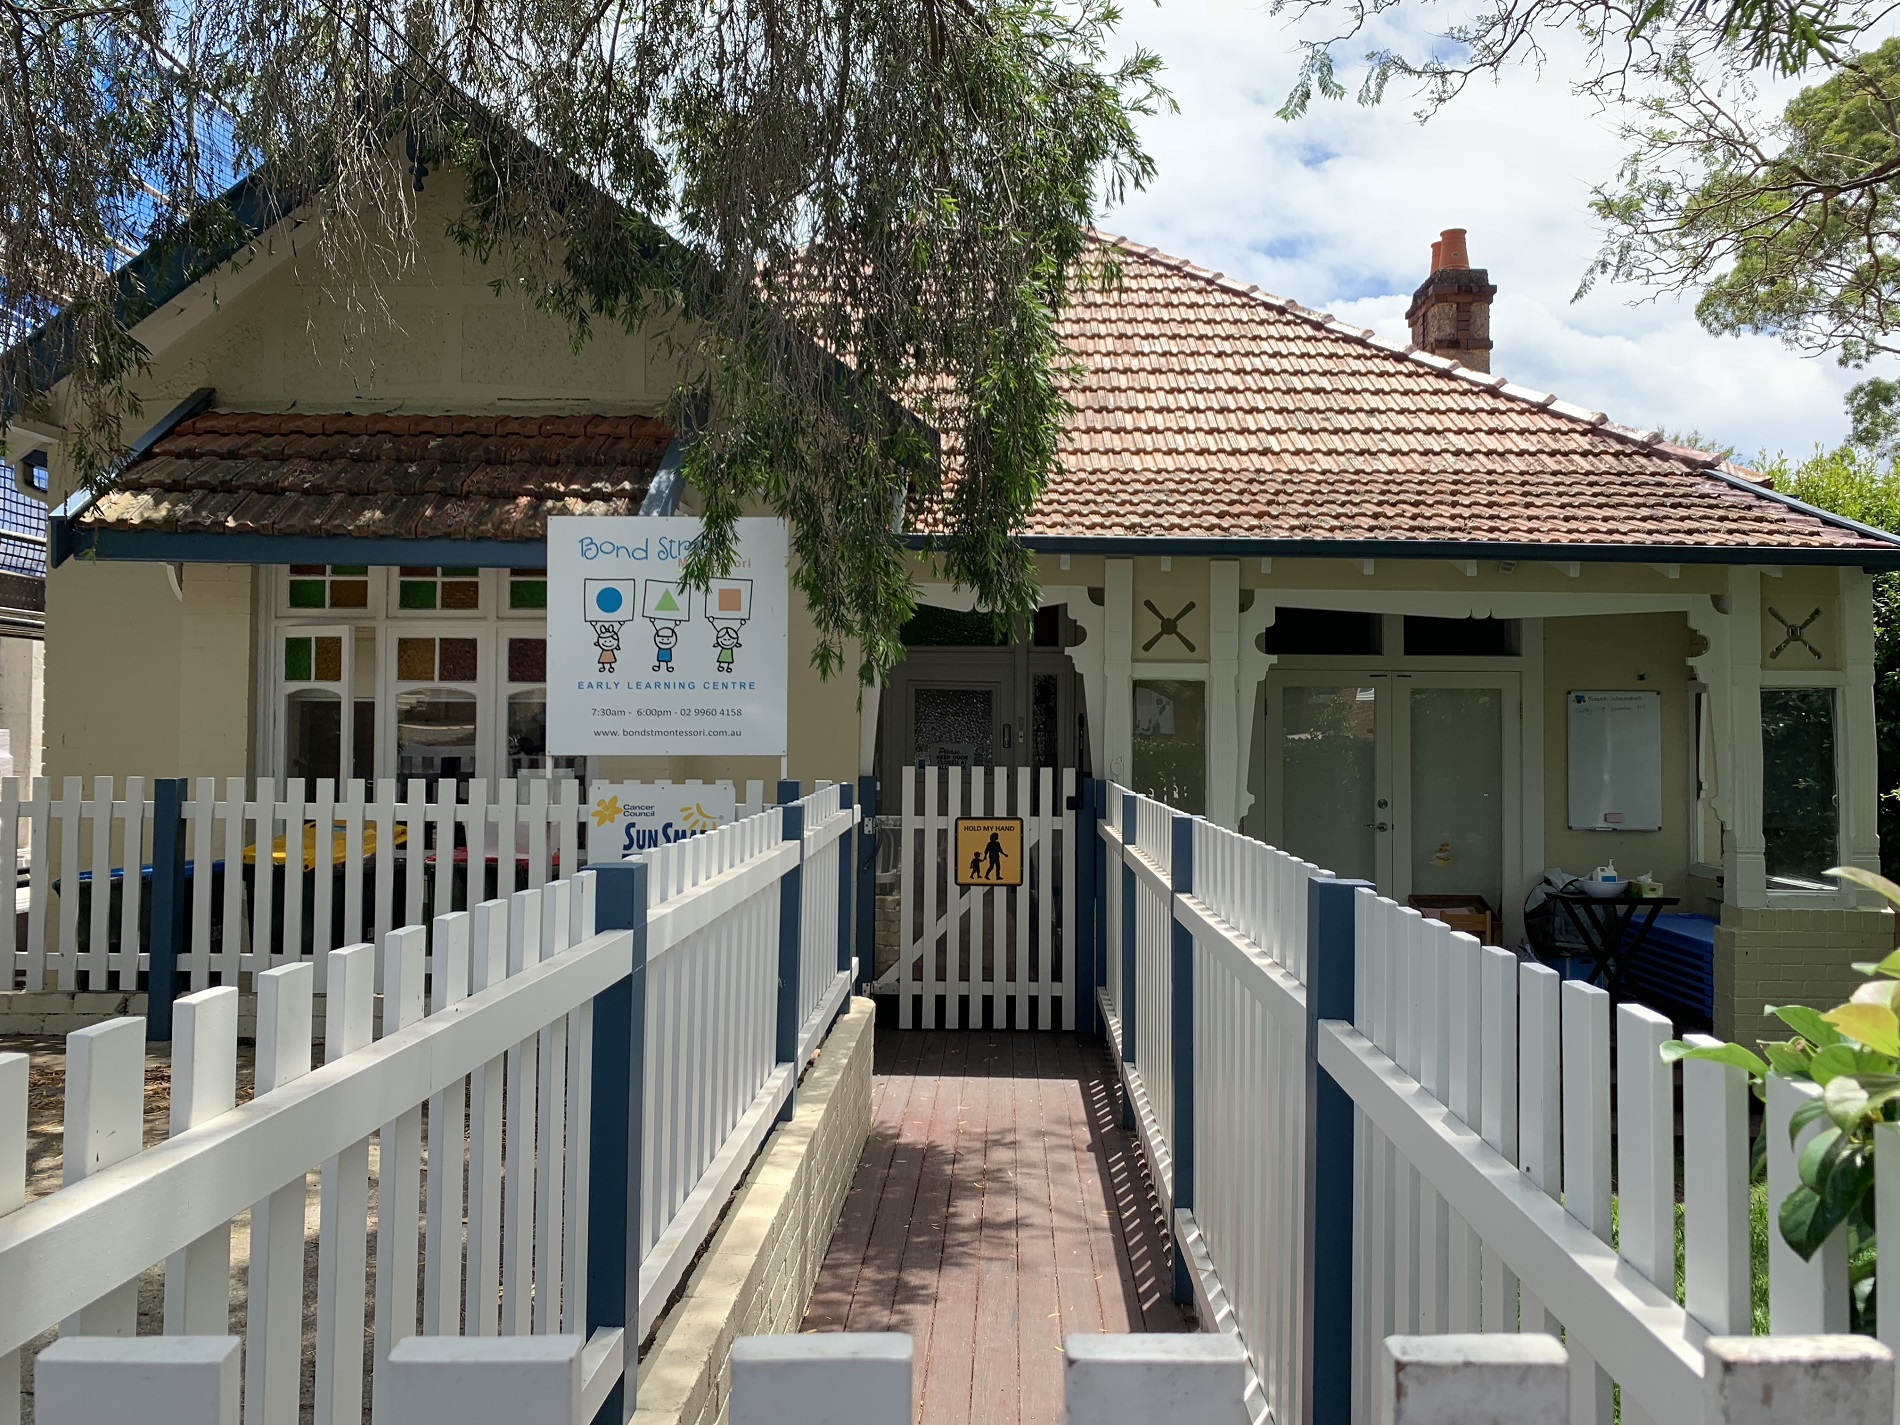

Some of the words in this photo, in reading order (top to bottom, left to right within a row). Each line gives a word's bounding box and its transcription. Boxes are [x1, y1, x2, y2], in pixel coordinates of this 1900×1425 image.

[578, 536, 649, 560] Bond
[577, 681, 620, 690] EARLY
[627, 681, 696, 690] LEARNING
[703, 681, 756, 690] CENTRE
[591, 708, 626, 717] 7:30am
[636, 708, 672, 718] 6:00pm
[680, 708, 692, 717] 02
[694, 708, 717, 717] 9960
[719, 708, 742, 717] 4158
[622, 728, 742, 737] bondstmontessori.com.au
[623, 803, 655, 811] Cancer
